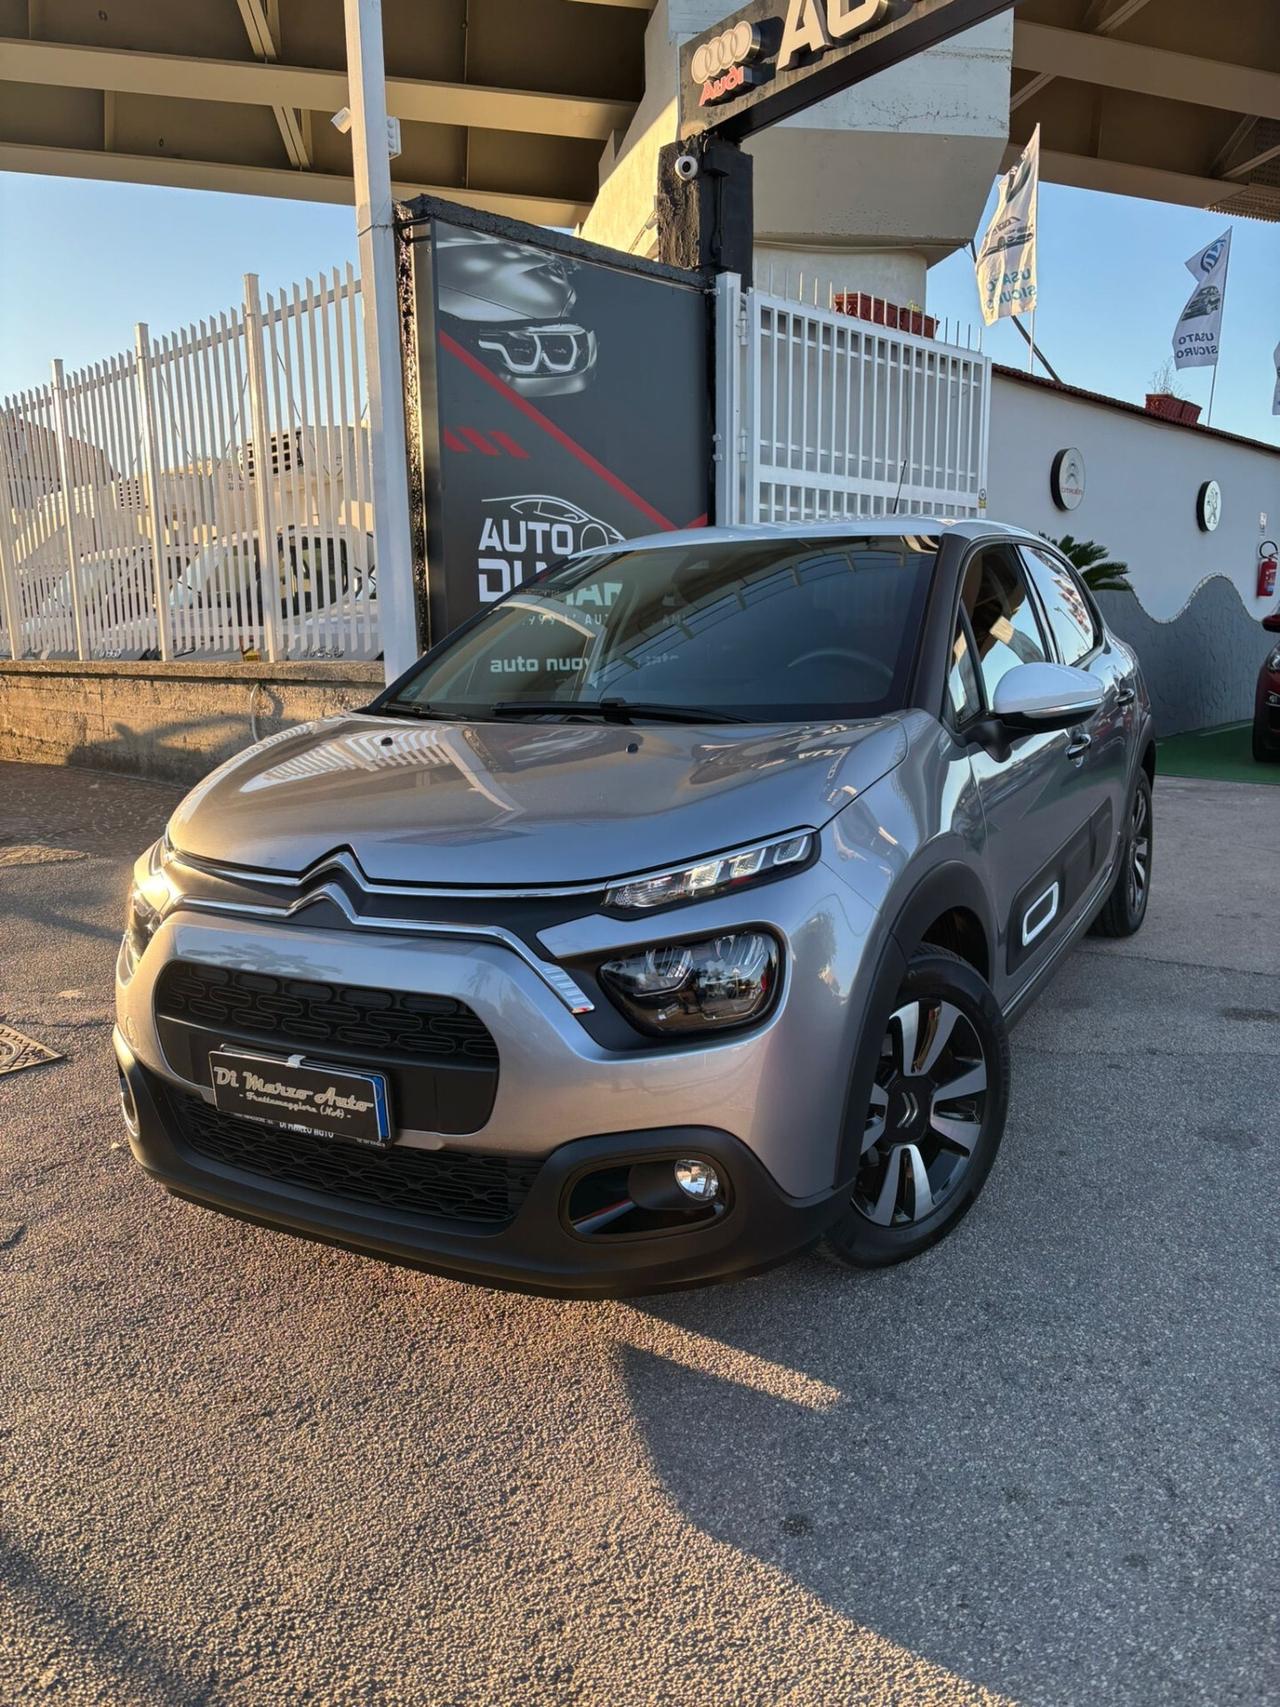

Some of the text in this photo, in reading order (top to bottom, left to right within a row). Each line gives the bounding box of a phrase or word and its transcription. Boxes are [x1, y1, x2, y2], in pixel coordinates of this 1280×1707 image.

[698, 65, 745, 107] Audi
[478, 517, 574, 555] AUTO
[490, 656, 539, 672] auto
[213, 1066, 374, 1112] Di Marzo Auto
